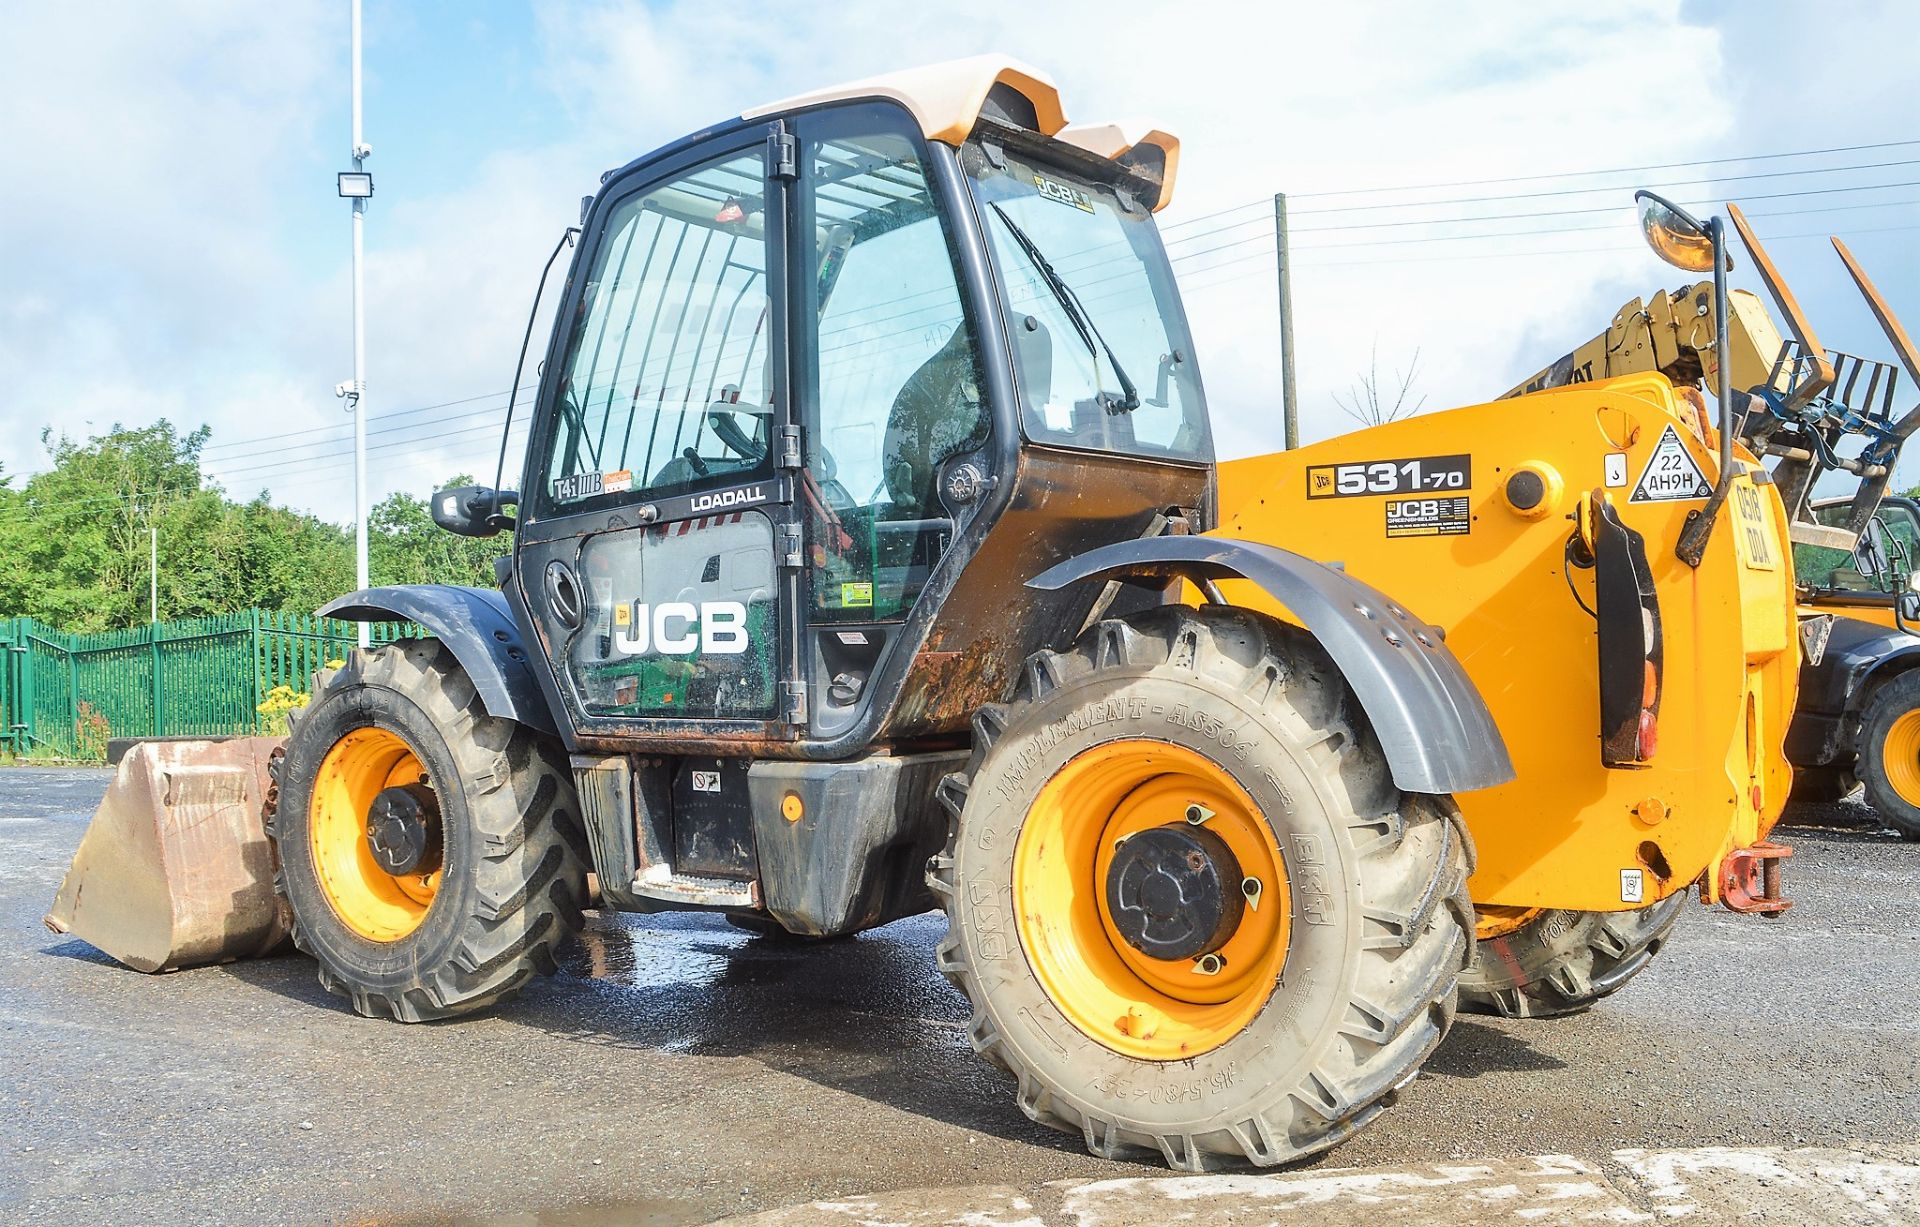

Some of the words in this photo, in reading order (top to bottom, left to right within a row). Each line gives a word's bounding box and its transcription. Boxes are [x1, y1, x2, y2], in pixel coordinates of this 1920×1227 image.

[1037, 178, 1074, 202] JCB
[1661, 454, 1682, 471] 22
[1337, 461, 1464, 495] 531-70
[1649, 473, 1693, 491] AH9H
[690, 486, 767, 512] LOADALL
[1387, 500, 1439, 518] JCB
[1746, 528, 1771, 565] DDA
[615, 601, 749, 655] JCB
[1292, 835, 1332, 925] BKT
